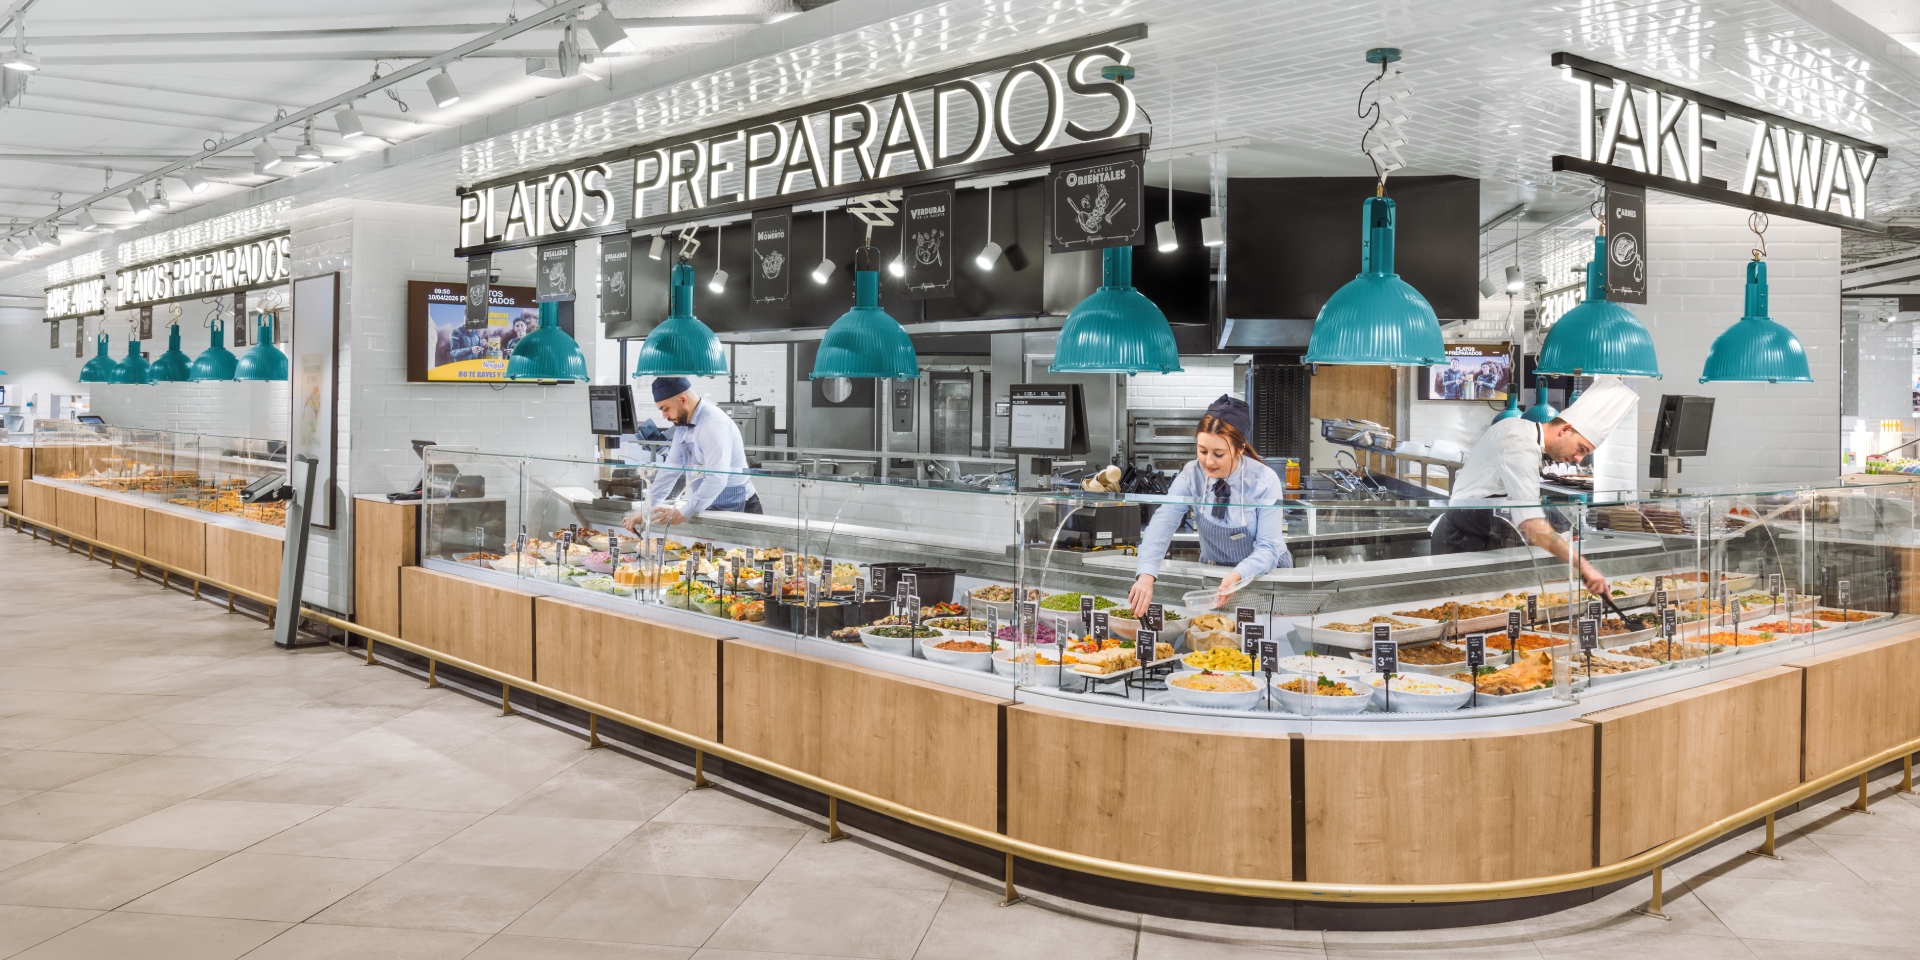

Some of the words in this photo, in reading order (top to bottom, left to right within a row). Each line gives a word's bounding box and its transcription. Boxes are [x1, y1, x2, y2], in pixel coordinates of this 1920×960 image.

[459, 162, 614, 248] PLATOS
[632, 43, 1136, 220] PREPARADOS
[1562, 65, 1728, 190] TAKE
[1742, 121, 1878, 219] AWAY
[1089, 166, 1113, 174] PLATOS
[1066, 169, 1126, 187] ORIENTALES
[910, 205, 946, 220] VERDURAS
[1616, 208, 1637, 219] CARNES
[758, 231, 785, 241] MOMENTO
[543, 248, 568, 261] ENSALADAS
[604, 252, 627, 262] ENSALADAS
[117, 263, 170, 307] PLATOS
[173, 237, 290, 298] PREPARADOS
[71, 279, 104, 314] AWAY
[482, 362, 505, 370] Nesquik
